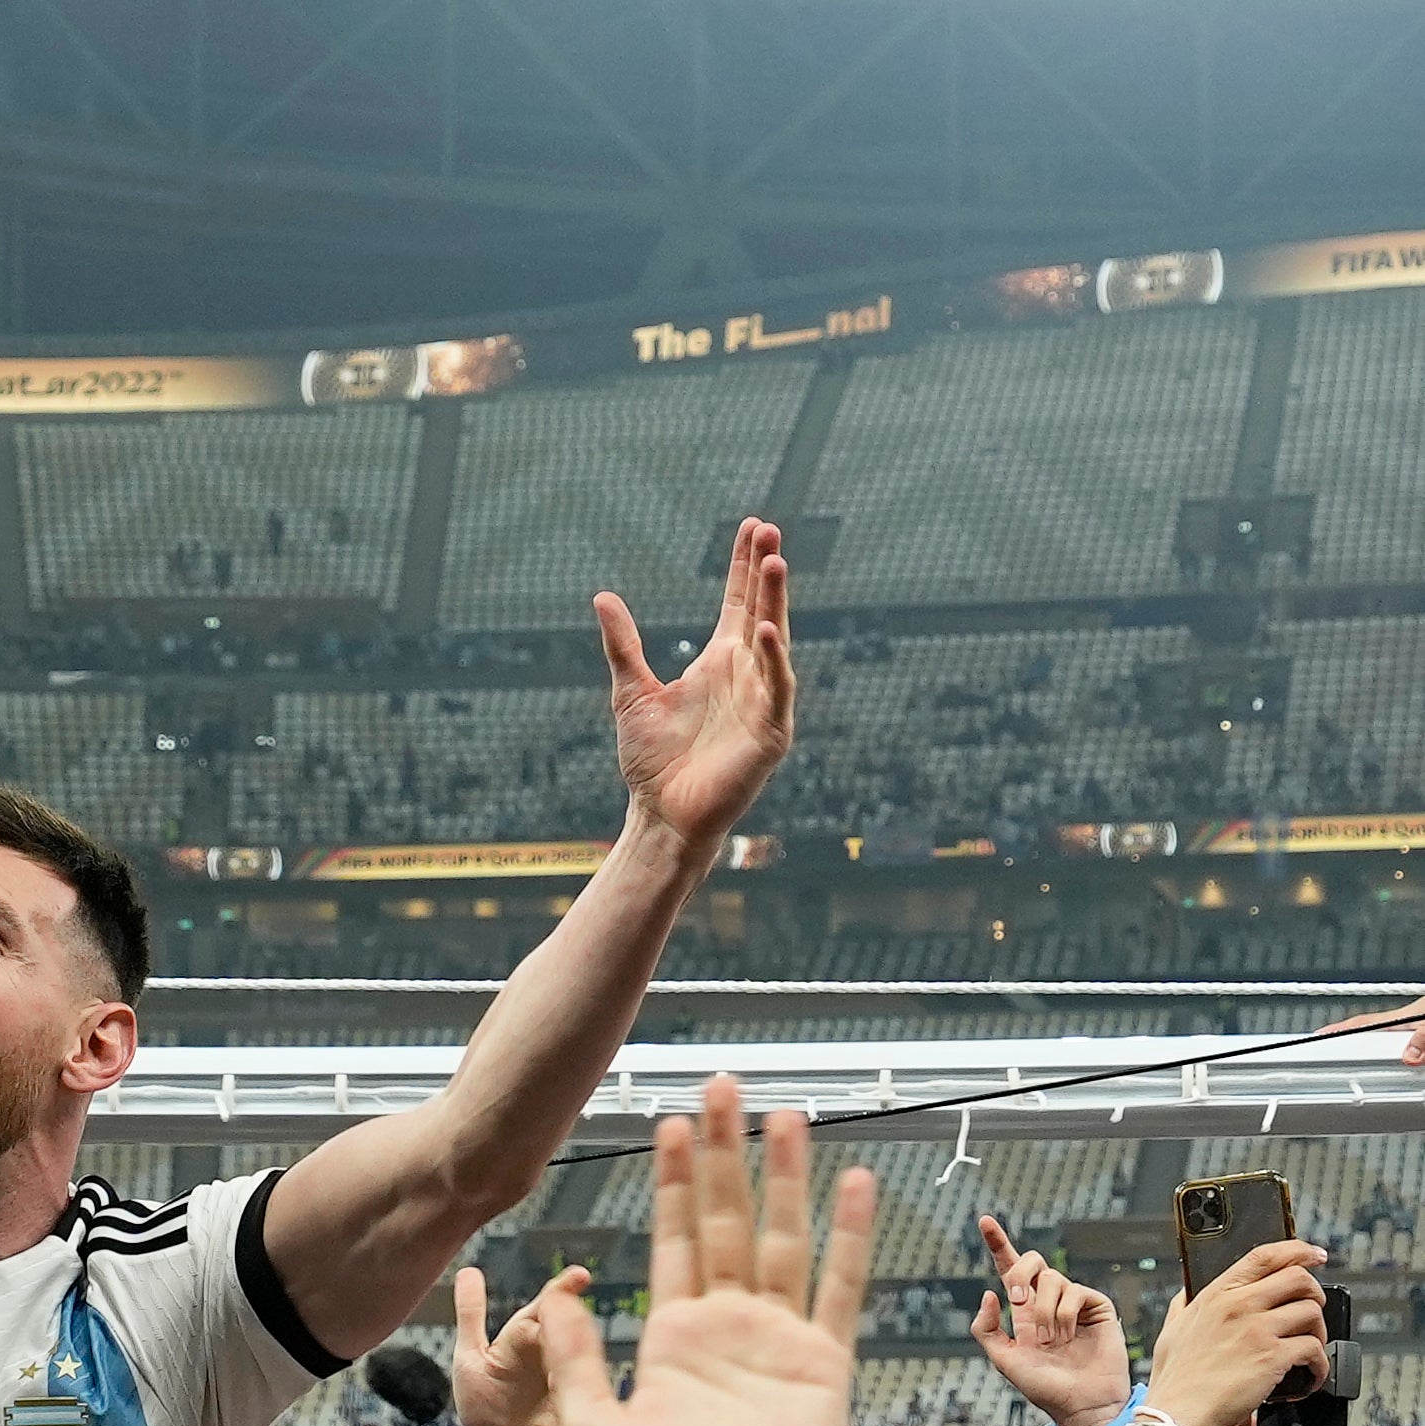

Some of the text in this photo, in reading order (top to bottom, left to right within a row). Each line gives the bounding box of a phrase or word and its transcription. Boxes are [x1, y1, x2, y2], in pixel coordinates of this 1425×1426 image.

[1329, 249, 1394, 275] FIFA
[631, 295, 894, 364] The Final
